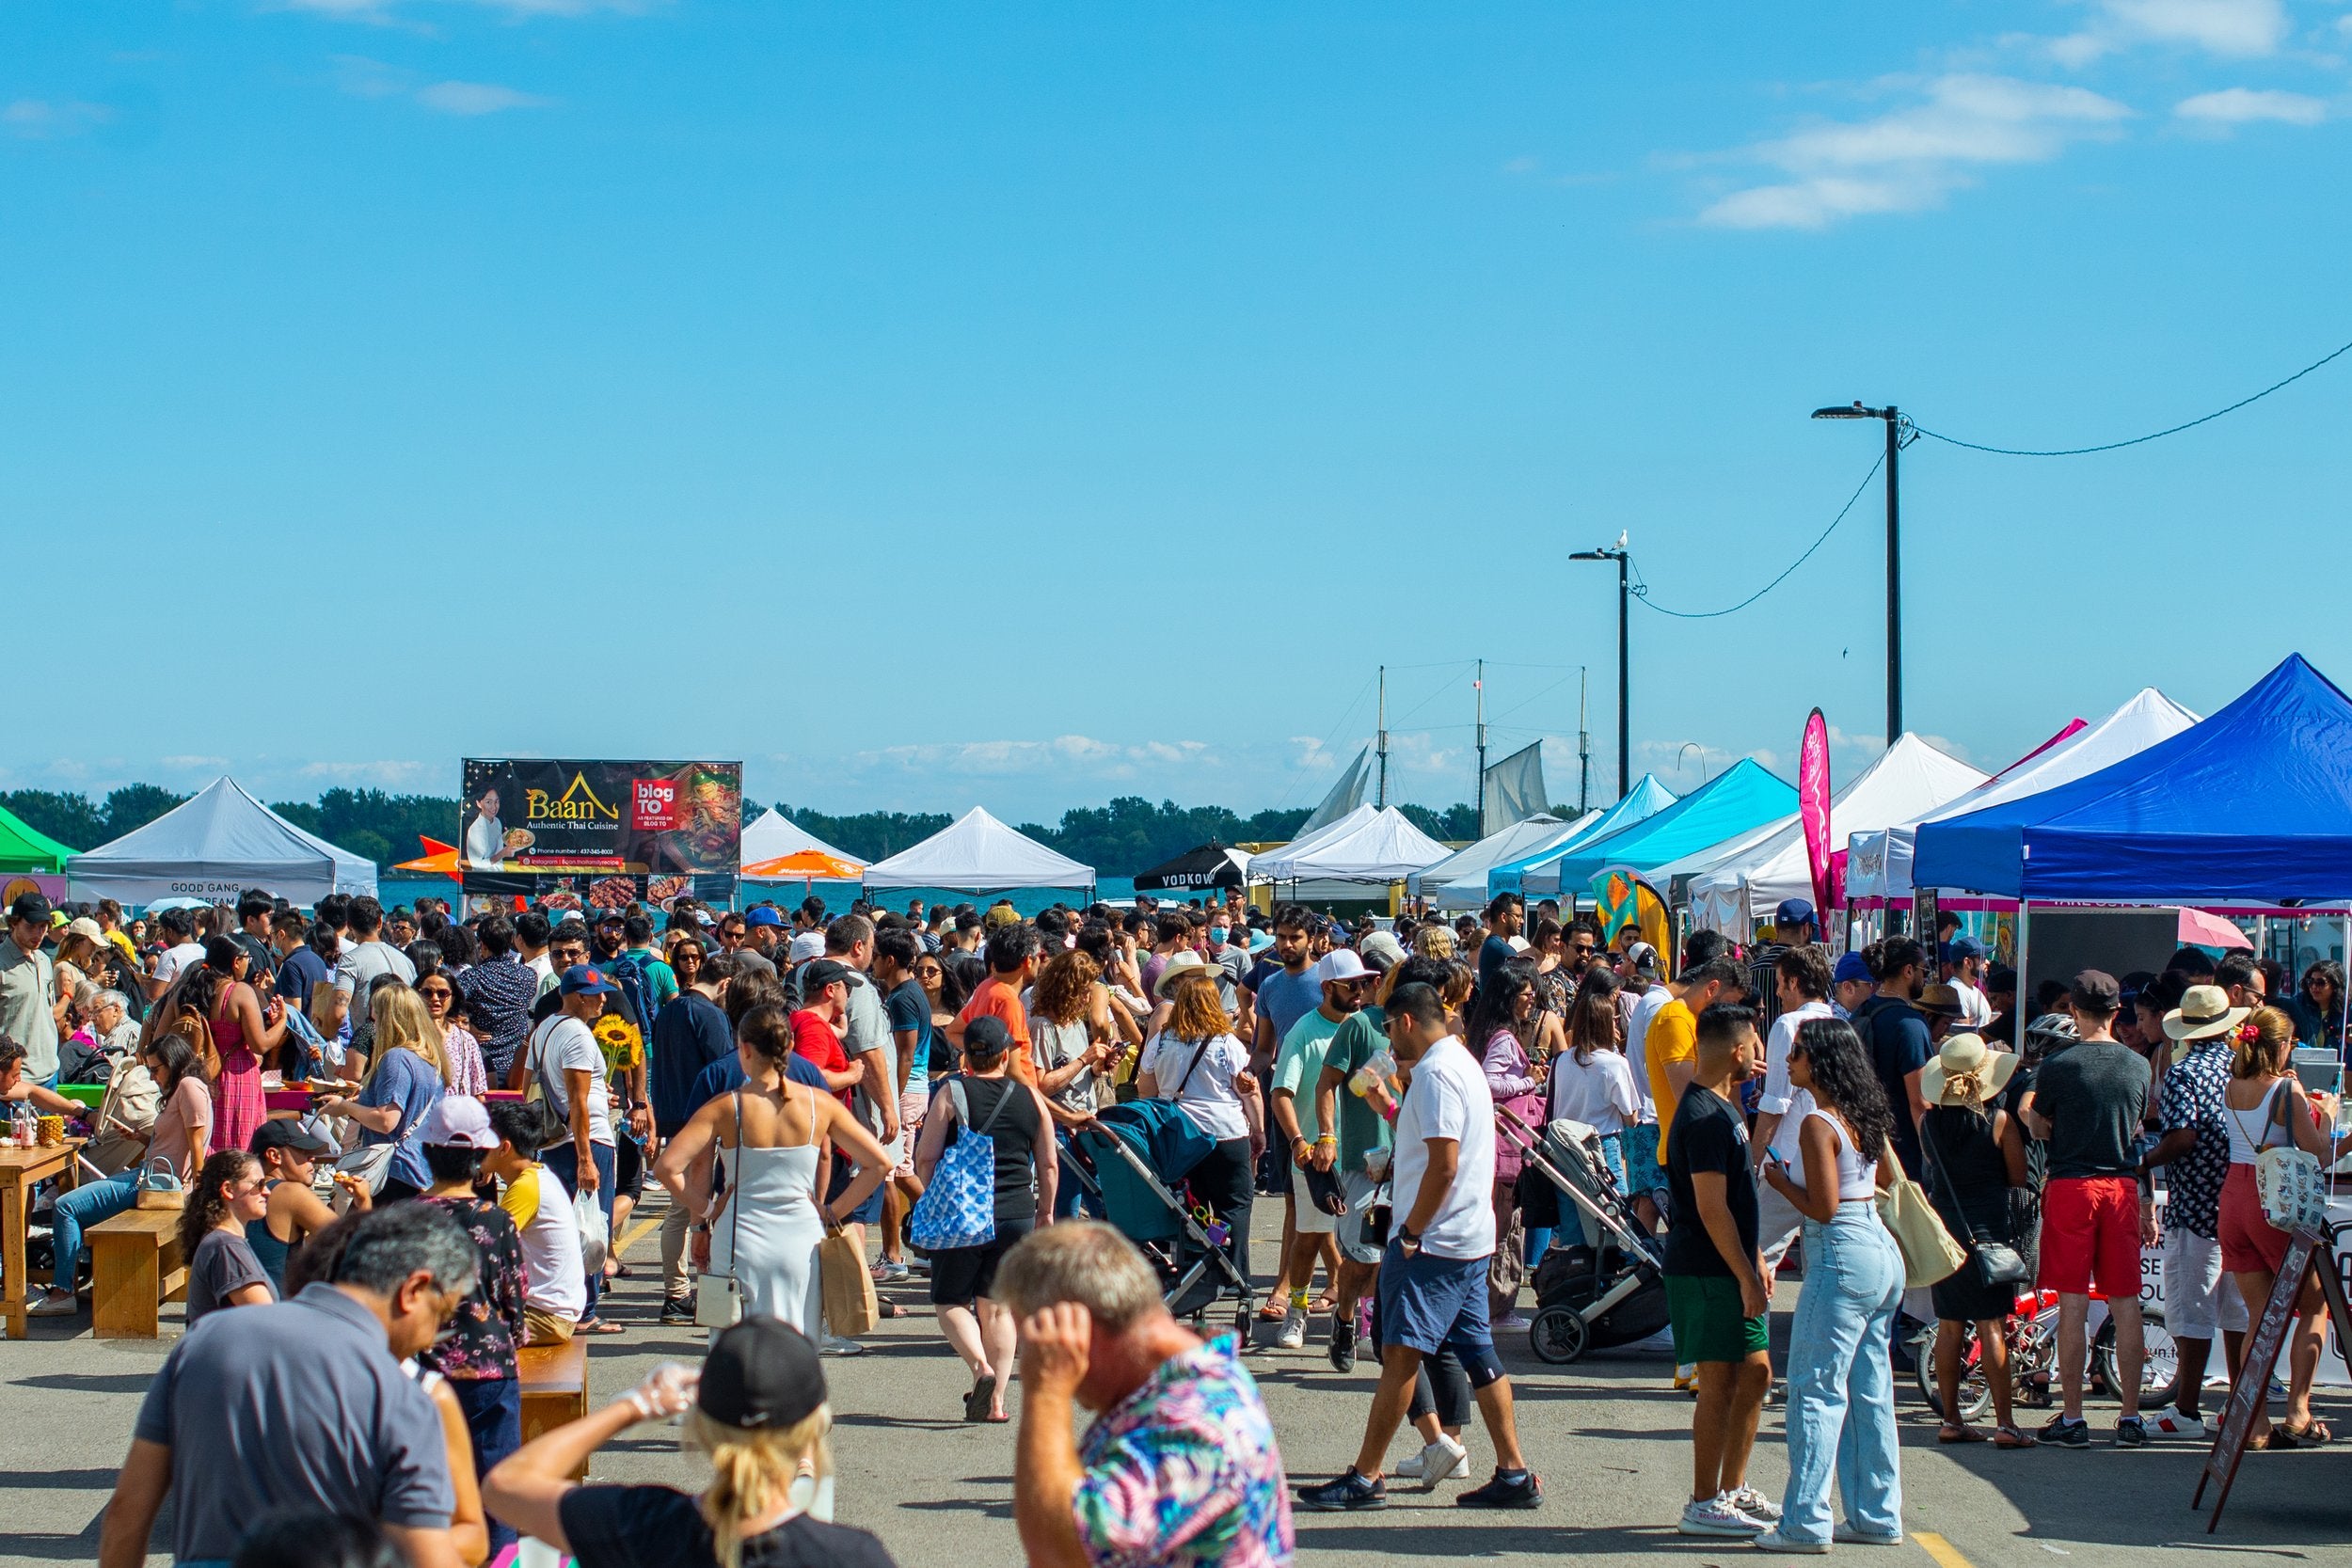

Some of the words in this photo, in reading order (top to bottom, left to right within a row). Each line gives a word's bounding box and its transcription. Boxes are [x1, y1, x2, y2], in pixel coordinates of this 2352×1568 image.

[638, 784, 674, 802] blog
[525, 787, 596, 819] Baan
[638, 800, 662, 814] TO
[526, 821, 566, 830] Authentic
[566, 821, 586, 830] Thai
[587, 821, 619, 831] Cuisine
[1162, 873, 1213, 887] VODKOW
[171, 882, 204, 893] GOOD
[207, 882, 239, 893] GANG
